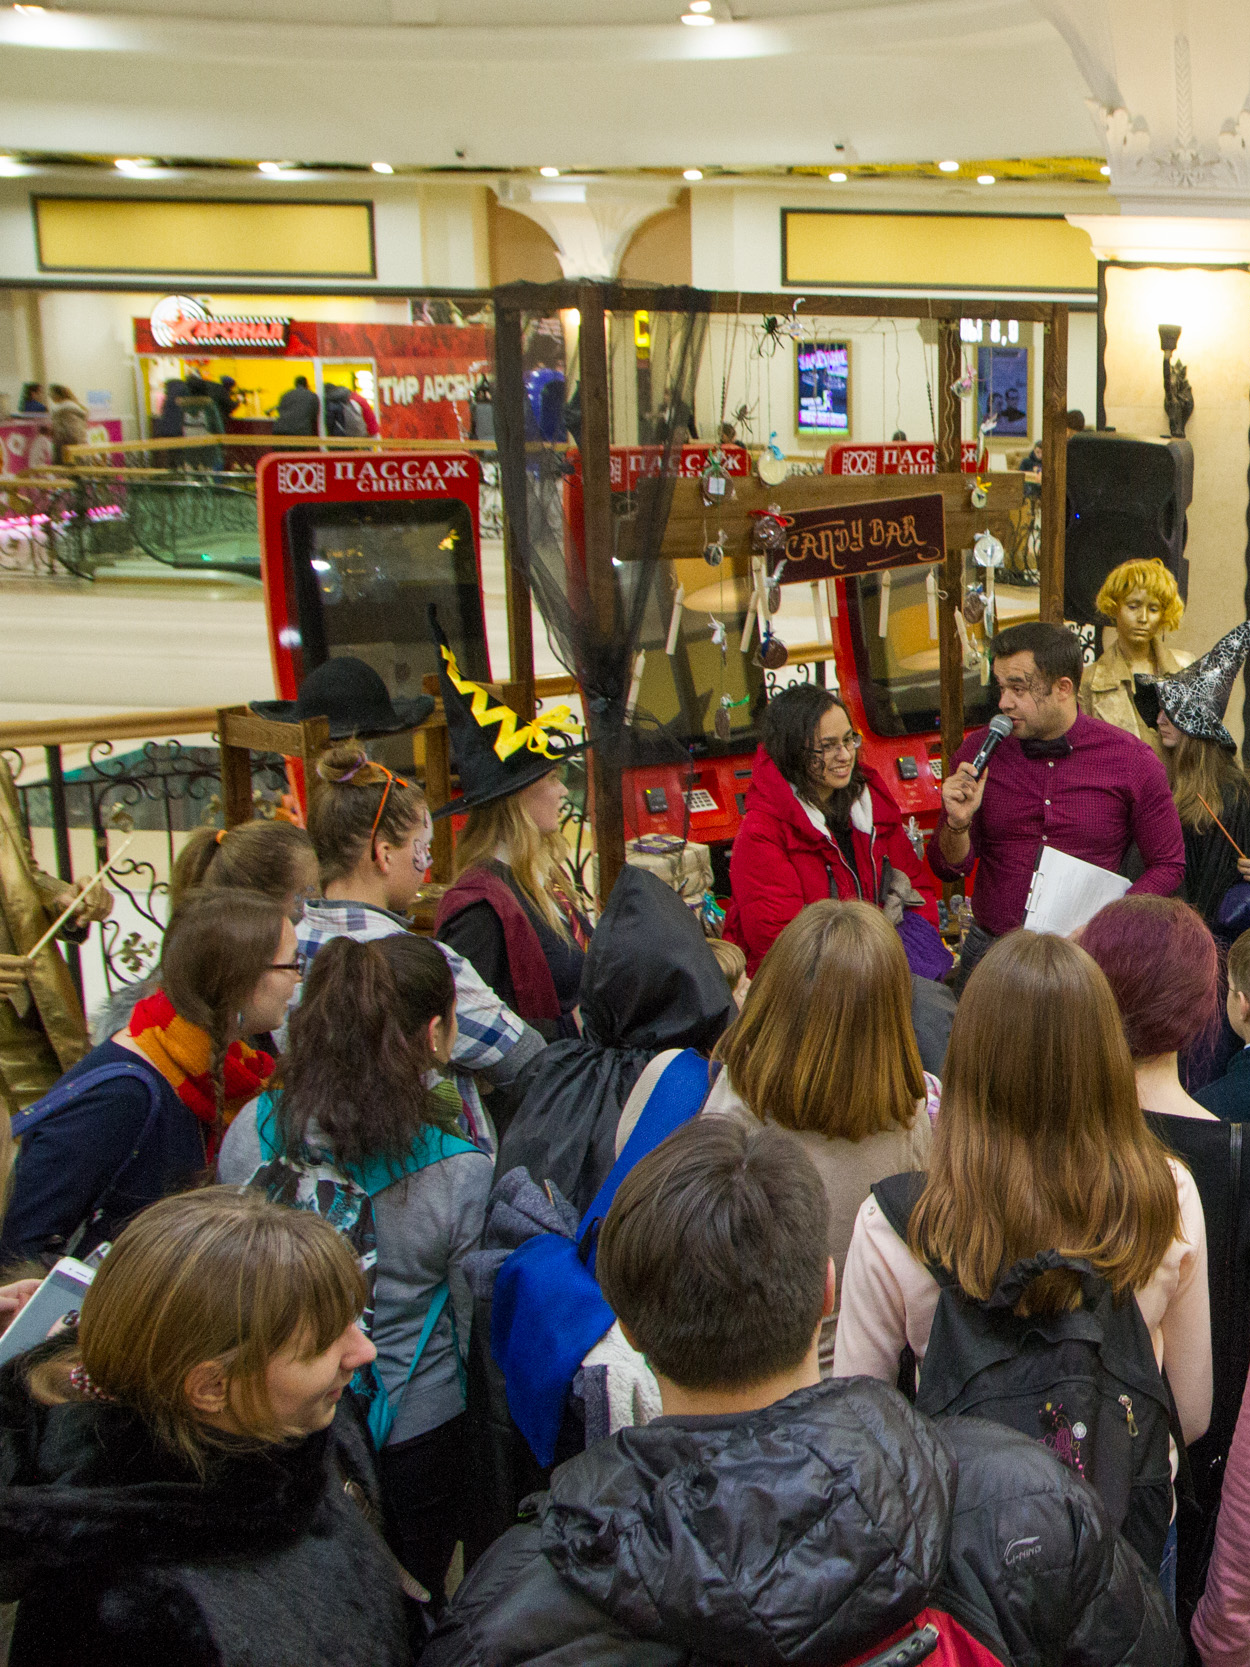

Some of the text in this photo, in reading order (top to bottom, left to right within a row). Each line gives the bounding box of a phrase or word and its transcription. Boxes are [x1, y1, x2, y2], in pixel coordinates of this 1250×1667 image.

[379, 376, 419, 406] ТИР
[334, 460, 469, 480] ПАССАЖ
[356, 478, 448, 493] СИНЕМА
[785, 515, 927, 569] CANDY BAR
